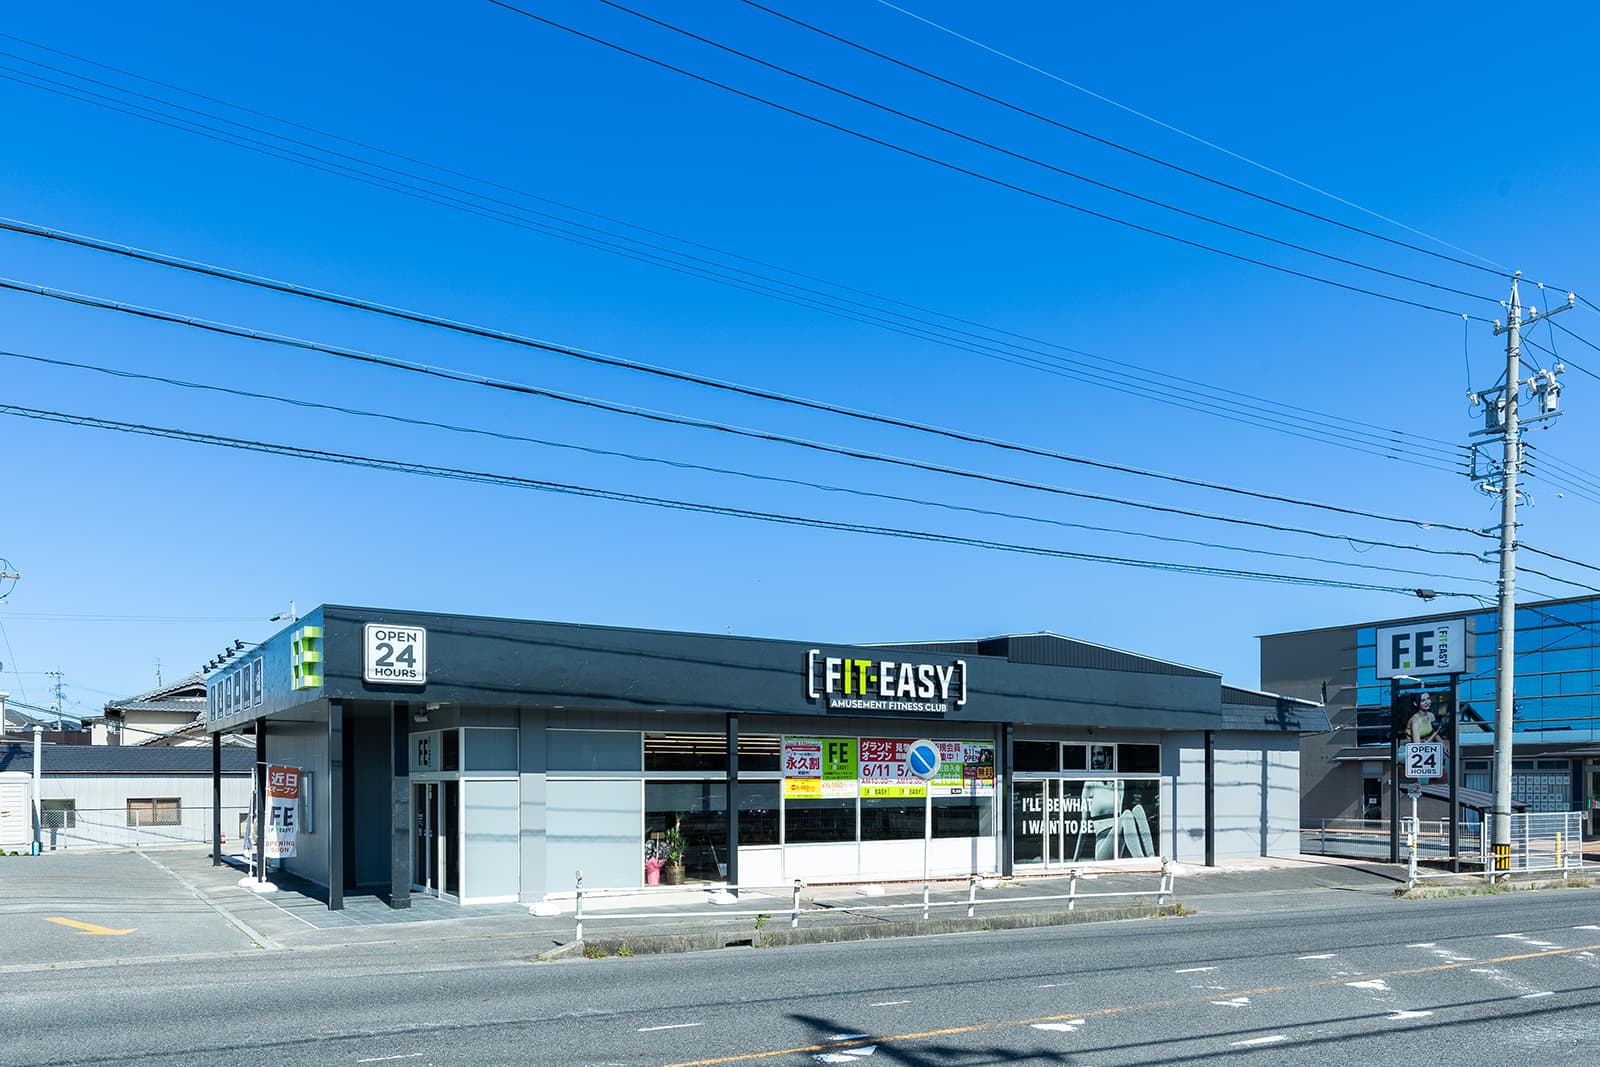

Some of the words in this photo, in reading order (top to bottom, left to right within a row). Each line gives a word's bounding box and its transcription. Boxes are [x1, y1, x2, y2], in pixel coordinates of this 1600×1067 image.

[375, 630, 417, 642] OPEN
[375, 643, 416, 668] 24
[375, 667, 417, 678] HOURS
[831, 699, 887, 710] AMUSEMENT
[888, 701, 924, 711] FITNESS
[925, 702, 947, 712] CLUB
[862, 741, 892, 751] グランド
[935, 743, 961, 752] 規会員
[862, 751, 892, 761] オープン
[1411, 754, 1437, 768] 24
[786, 756, 820, 770] 永久割
[863, 764, 890, 777] 6/11
[272, 772, 298, 786] 近日
[269, 786, 298, 795] オープン
[1022, 797, 1041, 812] I'LL
[1048, 799, 1060, 812] BE
[1062, 799, 1093, 812] WHAT
[1022, 820, 1026, 834] I
[1064, 820, 1079, 834] TO
